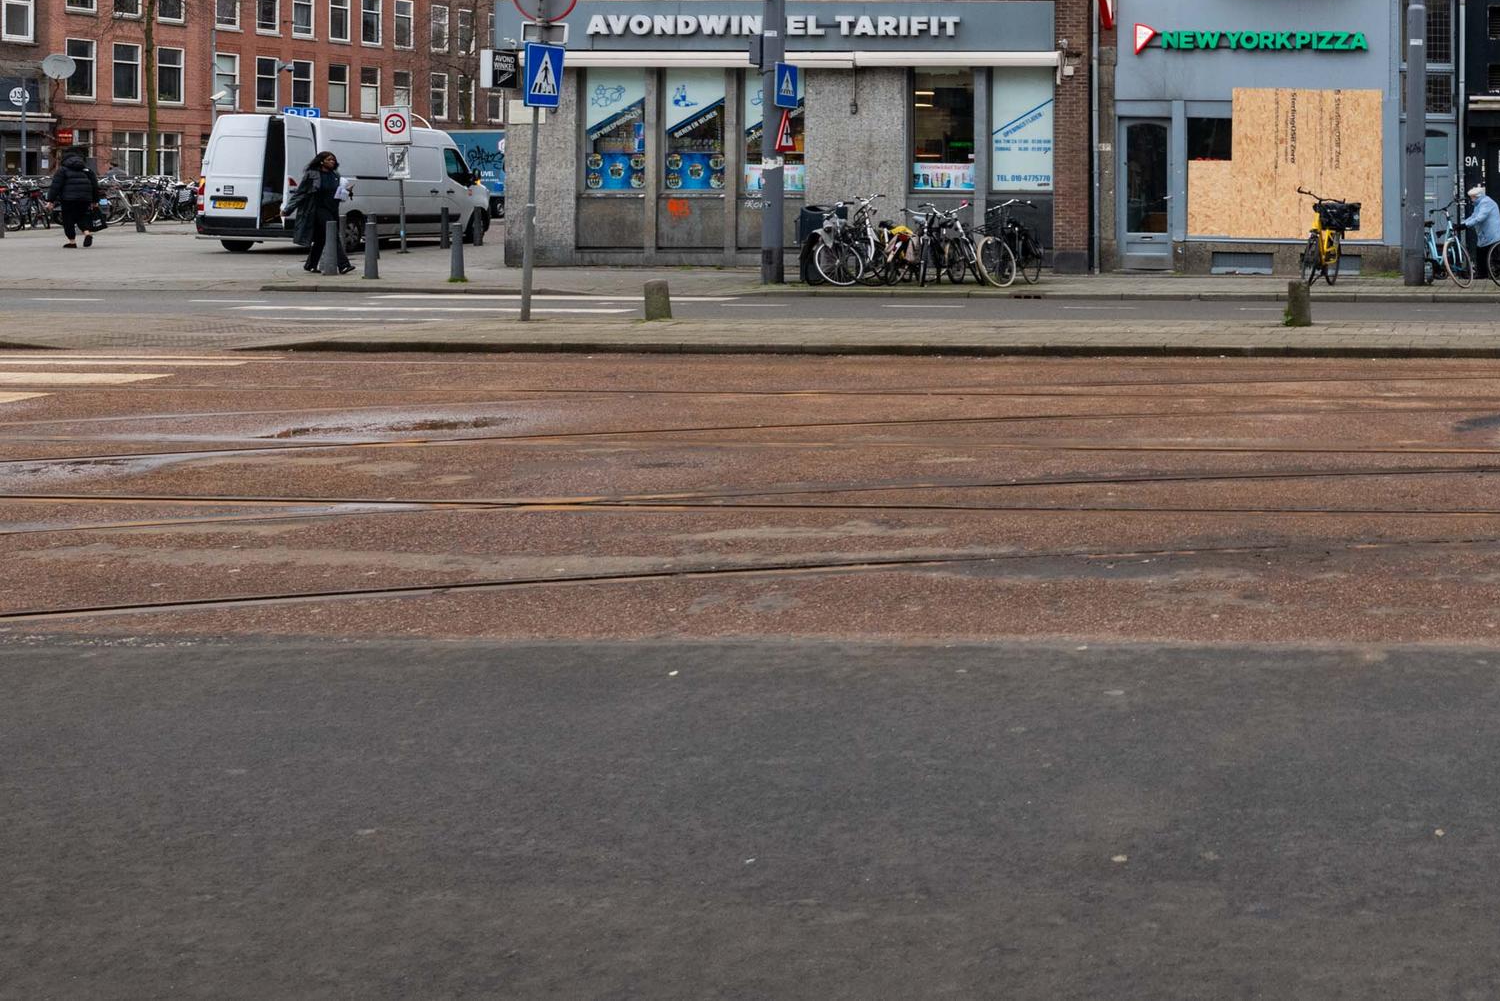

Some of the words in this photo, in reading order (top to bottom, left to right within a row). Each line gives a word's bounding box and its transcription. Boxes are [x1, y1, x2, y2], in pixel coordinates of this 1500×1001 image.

[586, 15, 825, 36] AVONDWINEL
[835, 15, 960, 36] TARIFIT
[1161, 31, 1221, 49] NEW
[1226, 31, 1294, 50] YORK
[1295, 32, 1369, 50] PIZZA
[495, 55, 515, 64] AVOND
[494, 62, 515, 71] WINKEL
[389, 120, 402, 128] 30
